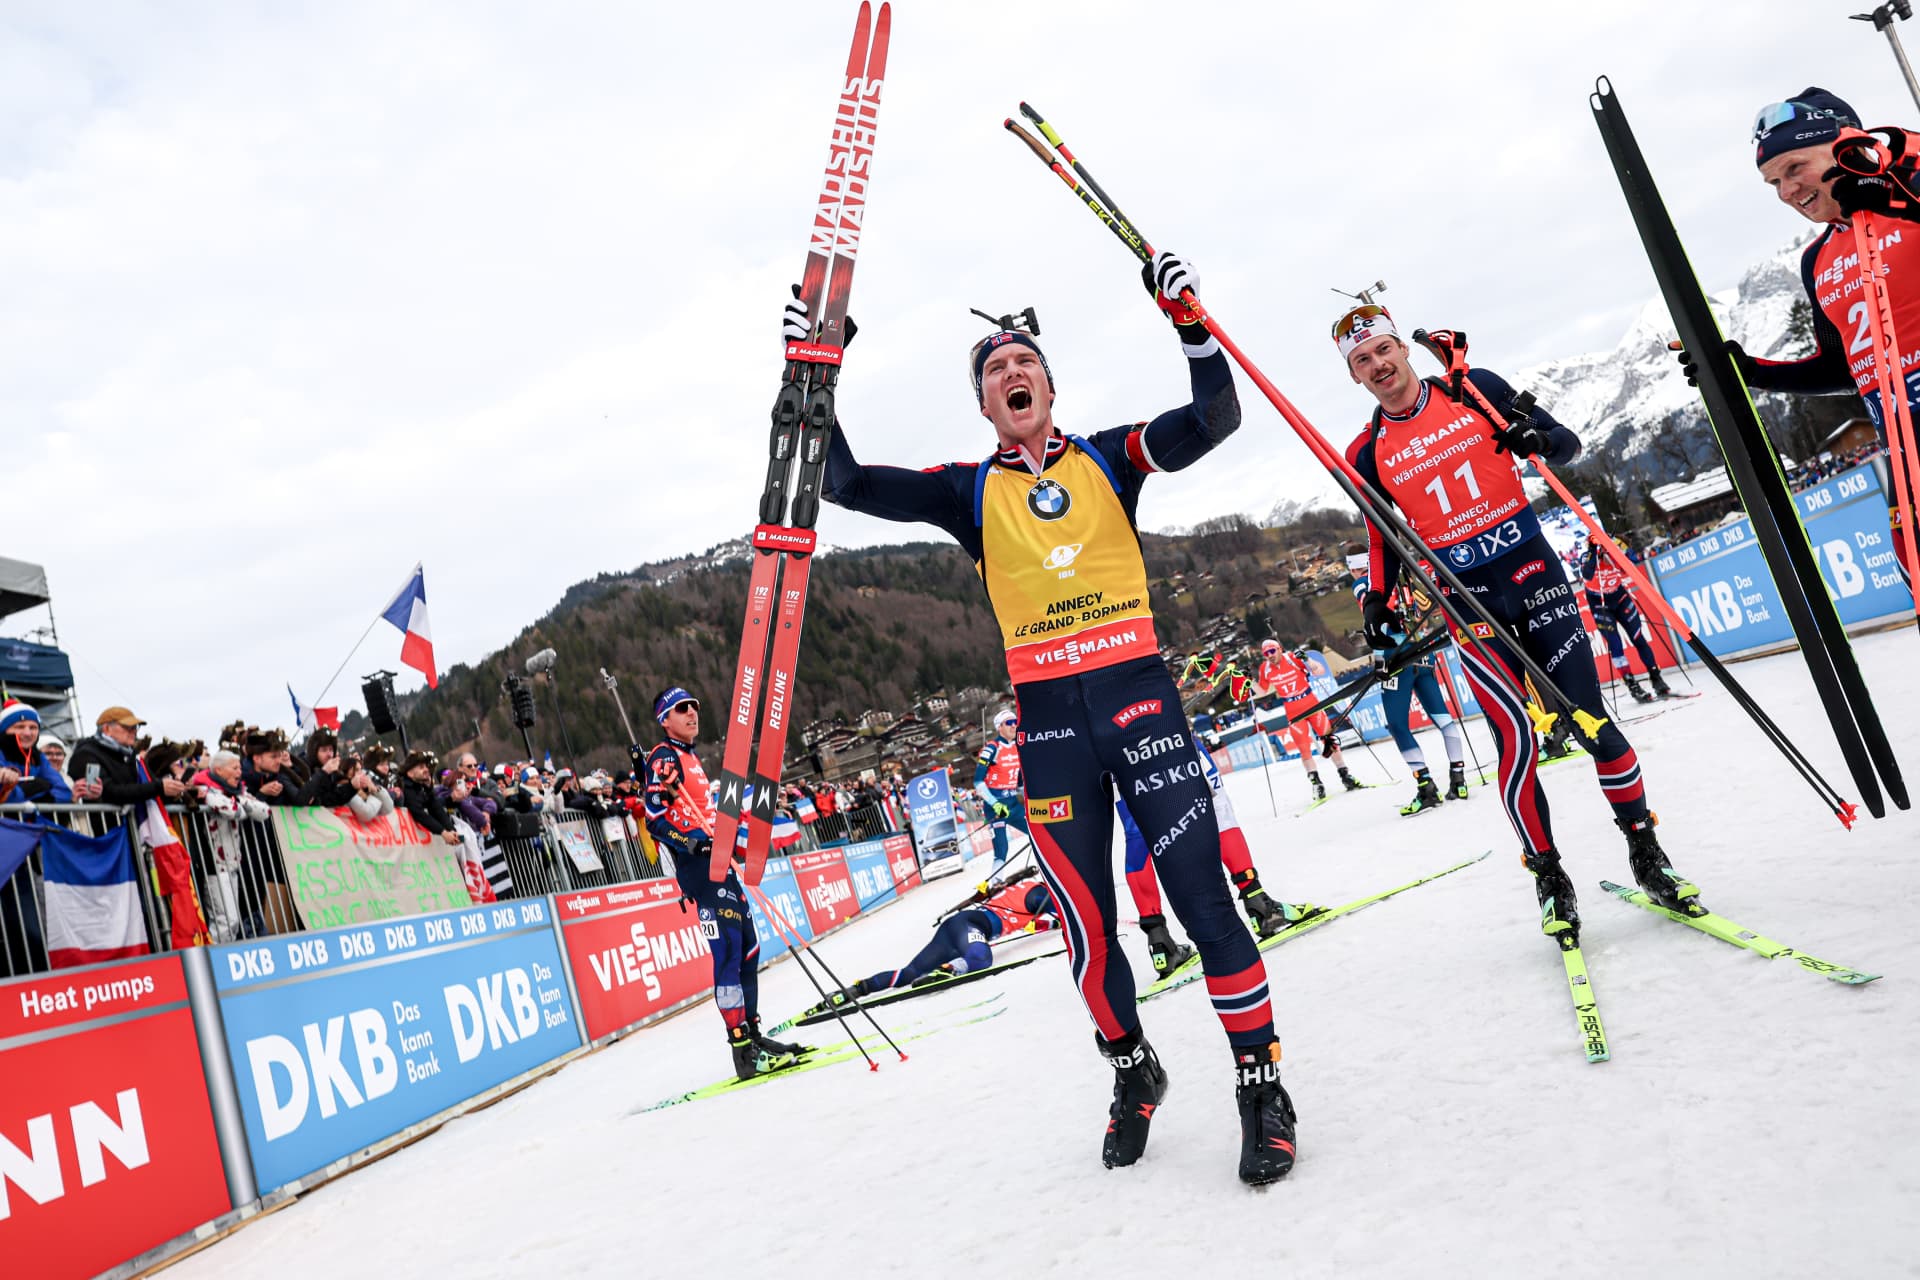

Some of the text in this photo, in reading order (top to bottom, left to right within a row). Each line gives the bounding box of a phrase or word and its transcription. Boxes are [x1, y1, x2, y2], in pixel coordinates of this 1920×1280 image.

[807, 75, 863, 257] MADSHUS
[834, 77, 885, 260] MADSHUS
[799, 348, 839, 359] MADSHUS
[1384, 414, 1475, 469] VIESSMANN
[1392, 433, 1484, 486] Wärmepumpen
[1425, 459, 1482, 515] 11
[1447, 500, 1490, 529] ANNECY
[1658, 473, 1868, 573] DKB DKB DKB DKB DKB DKB
[769, 533, 811, 544] MADSHUS
[1478, 520, 1522, 558] iX3
[1855, 531, 1882, 549] Das
[1516, 562, 1543, 581] MENY
[1863, 551, 1896, 569] kann
[1058, 569, 1076, 580] IBU
[1734, 575, 1753, 590] Das
[755, 586, 768, 596] 192
[787, 590, 800, 600] 192
[1046, 592, 1103, 616] ANNECY
[1740, 592, 1763, 606] kann
[1015, 598, 1141, 637] LE GRAND-BORNAND
[1671, 580, 1743, 637] DKB
[1746, 607, 1771, 625] Bank
[1034, 630, 1137, 665] VIESSMANN
[1546, 633, 1579, 673] CRAFT
[737, 665, 755, 726] REDLINE
[769, 670, 787, 730] REDLINE
[1282, 681, 1297, 694] 17
[1118, 703, 1158, 724] MENY
[1027, 727, 1076, 743] LAPUA
[1030, 806, 1048, 816] Uno
[280, 806, 344, 850] LES
[1153, 810, 1198, 857] CRAFT
[567, 895, 601, 915] VIESSMANN
[807, 875, 851, 920] VIESSMANN
[227, 903, 544, 983] DKB DKB DKB DKB DKB DKB DKB DKB
[533, 963, 552, 983] Das
[588, 921, 711, 1001] VIESSMANN
[20, 975, 155, 1018] Heat pumps
[538, 986, 561, 1006] kann
[392, 1001, 421, 1025] Das
[443, 967, 540, 1064] DKB
[544, 1007, 567, 1029] Bank
[399, 1030, 433, 1056] kann
[1581, 1015, 1605, 1057] FISCHER
[246, 1007, 399, 1142] DKB
[406, 1056, 441, 1084] Bank
